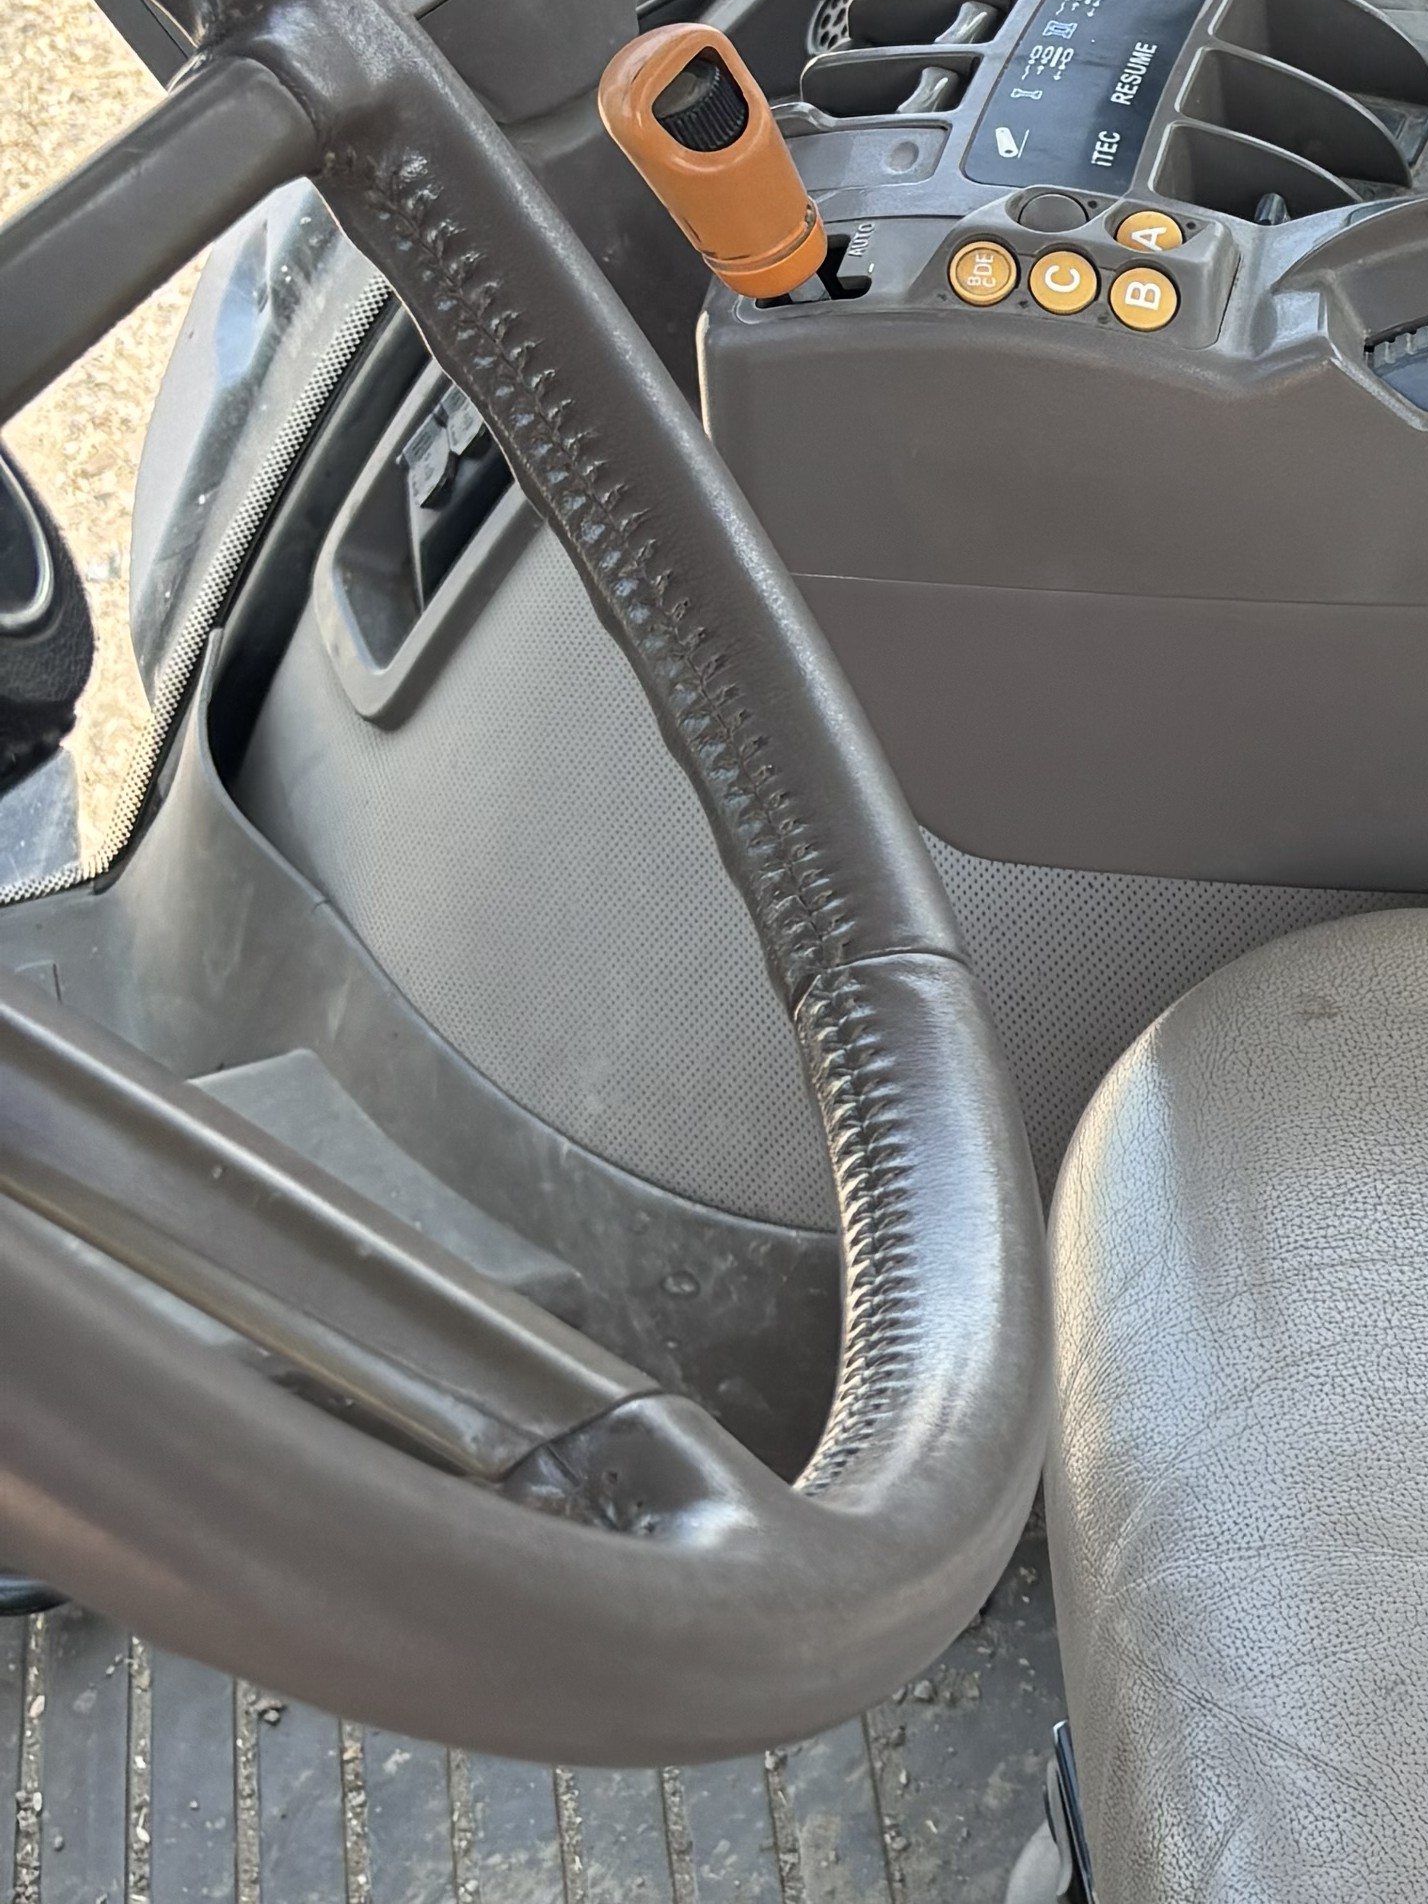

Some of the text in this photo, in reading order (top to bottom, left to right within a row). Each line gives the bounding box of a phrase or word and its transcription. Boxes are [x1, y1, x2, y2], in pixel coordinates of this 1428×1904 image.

[1110, 41, 1159, 106] RESUME
[848, 222, 875, 257] AUTO
[1131, 226, 1167, 252] A
[1044, 264, 1081, 293] C
[1124, 281, 1162, 311] B
